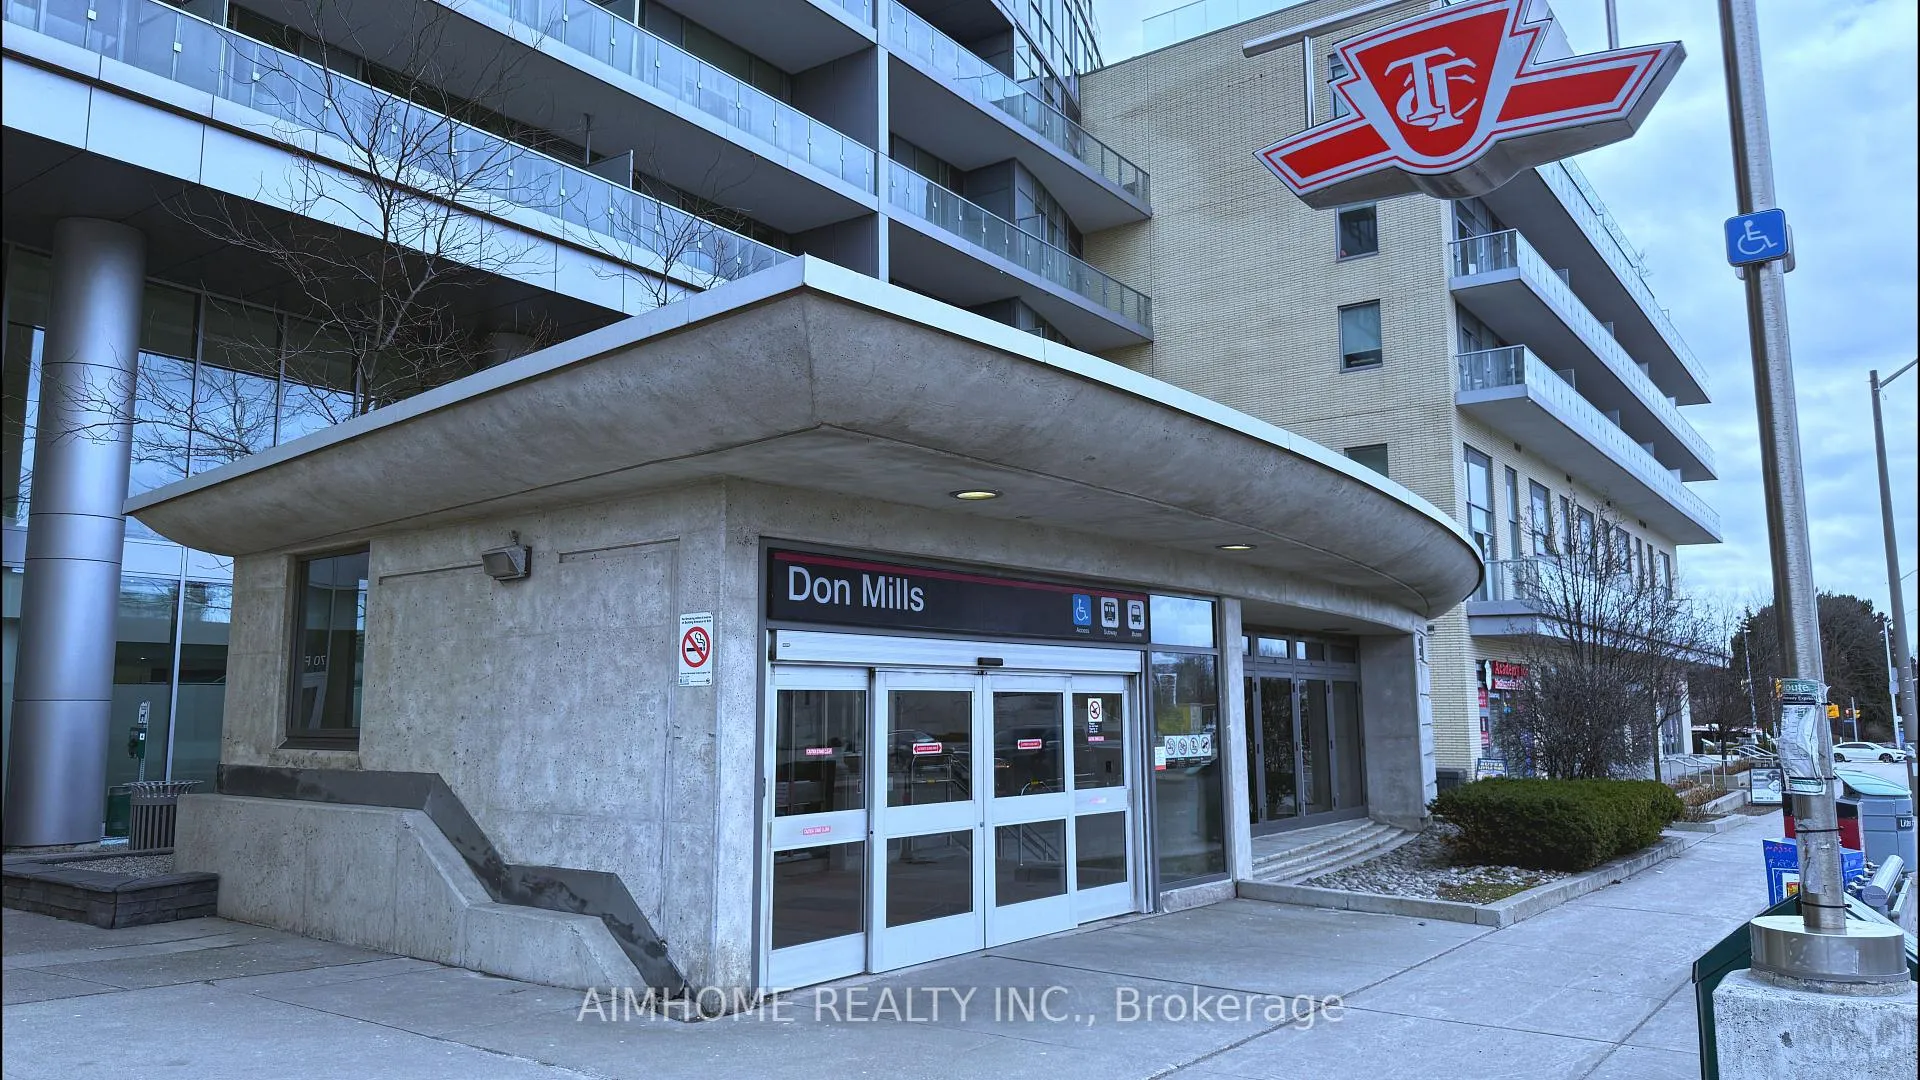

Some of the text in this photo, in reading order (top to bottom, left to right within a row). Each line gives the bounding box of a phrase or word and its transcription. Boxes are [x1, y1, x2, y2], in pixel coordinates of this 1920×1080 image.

[1384, 46, 1478, 132] TTC
[788, 565, 925, 612] Don Mills
